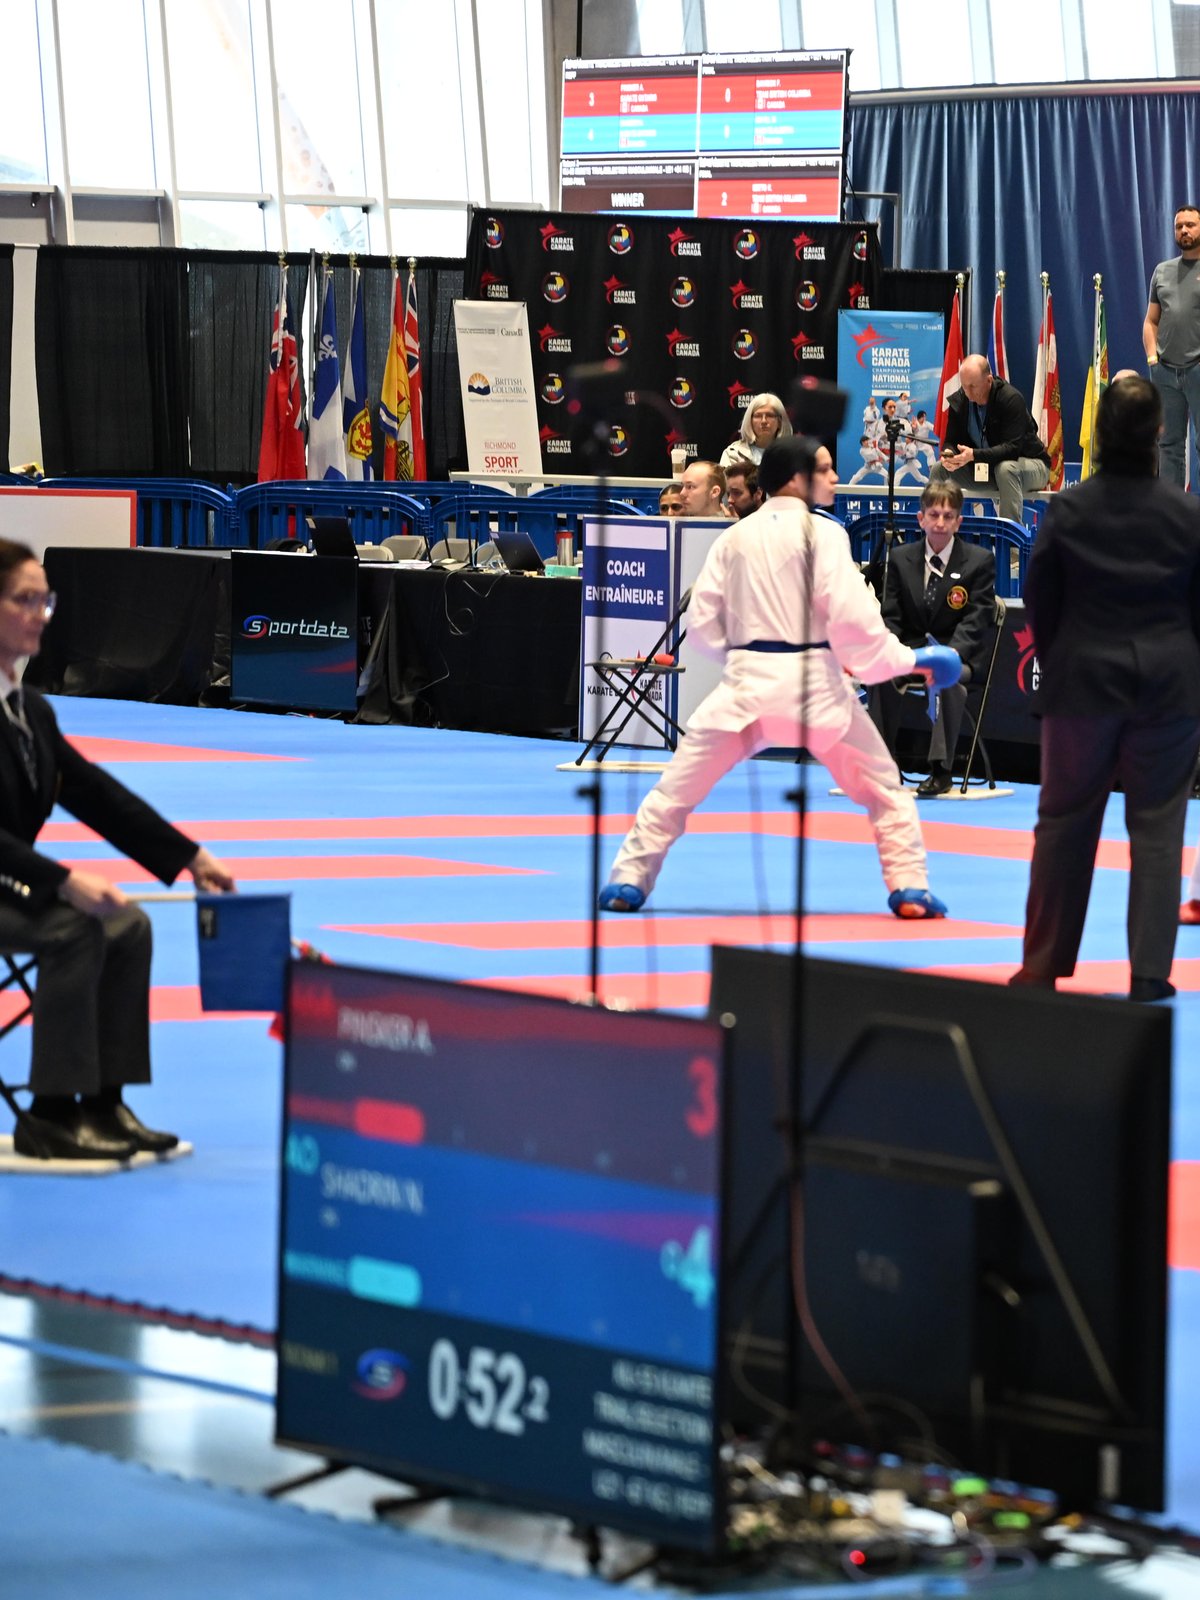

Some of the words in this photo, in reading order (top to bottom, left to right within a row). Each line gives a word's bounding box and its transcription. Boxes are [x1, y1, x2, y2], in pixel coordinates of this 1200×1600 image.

[611, 192, 645, 207] WINNER
[550, 237, 574, 245] KARATE
[550, 243, 574, 251] CANADA
[678, 242, 702, 250] KARATE
[678, 249, 702, 257] CANADA
[487, 284, 509, 292] KARATE
[487, 291, 509, 299] CANADA
[613, 290, 636, 298] KARATE
[741, 295, 763, 303] KARATE
[741, 301, 763, 309] CANADA
[548, 338, 572, 346] KARATE
[548, 345, 572, 353] CANADA
[675, 343, 700, 351] KARATE
[802, 346, 825, 354] KARATE
[675, 349, 700, 357] CANADA
[802, 352, 825, 360] CANADA
[872, 347, 910, 358] KARATE
[872, 357, 911, 367] CANADA
[495, 377, 523, 386] BRITISH
[872, 374, 910, 383] NATIONAL
[491, 386, 527, 394] COLUMBIA
[484, 441, 517, 450] RICHMOND
[547, 440, 572, 448] KARATE
[547, 446, 572, 454] CANADA
[484, 456, 519, 469] SPORT
[606, 559, 646, 578] COACH
[587, 685, 613, 697] KARATE
[685, 1056, 718, 1138] 3
[678, 1225, 715, 1311] 4
